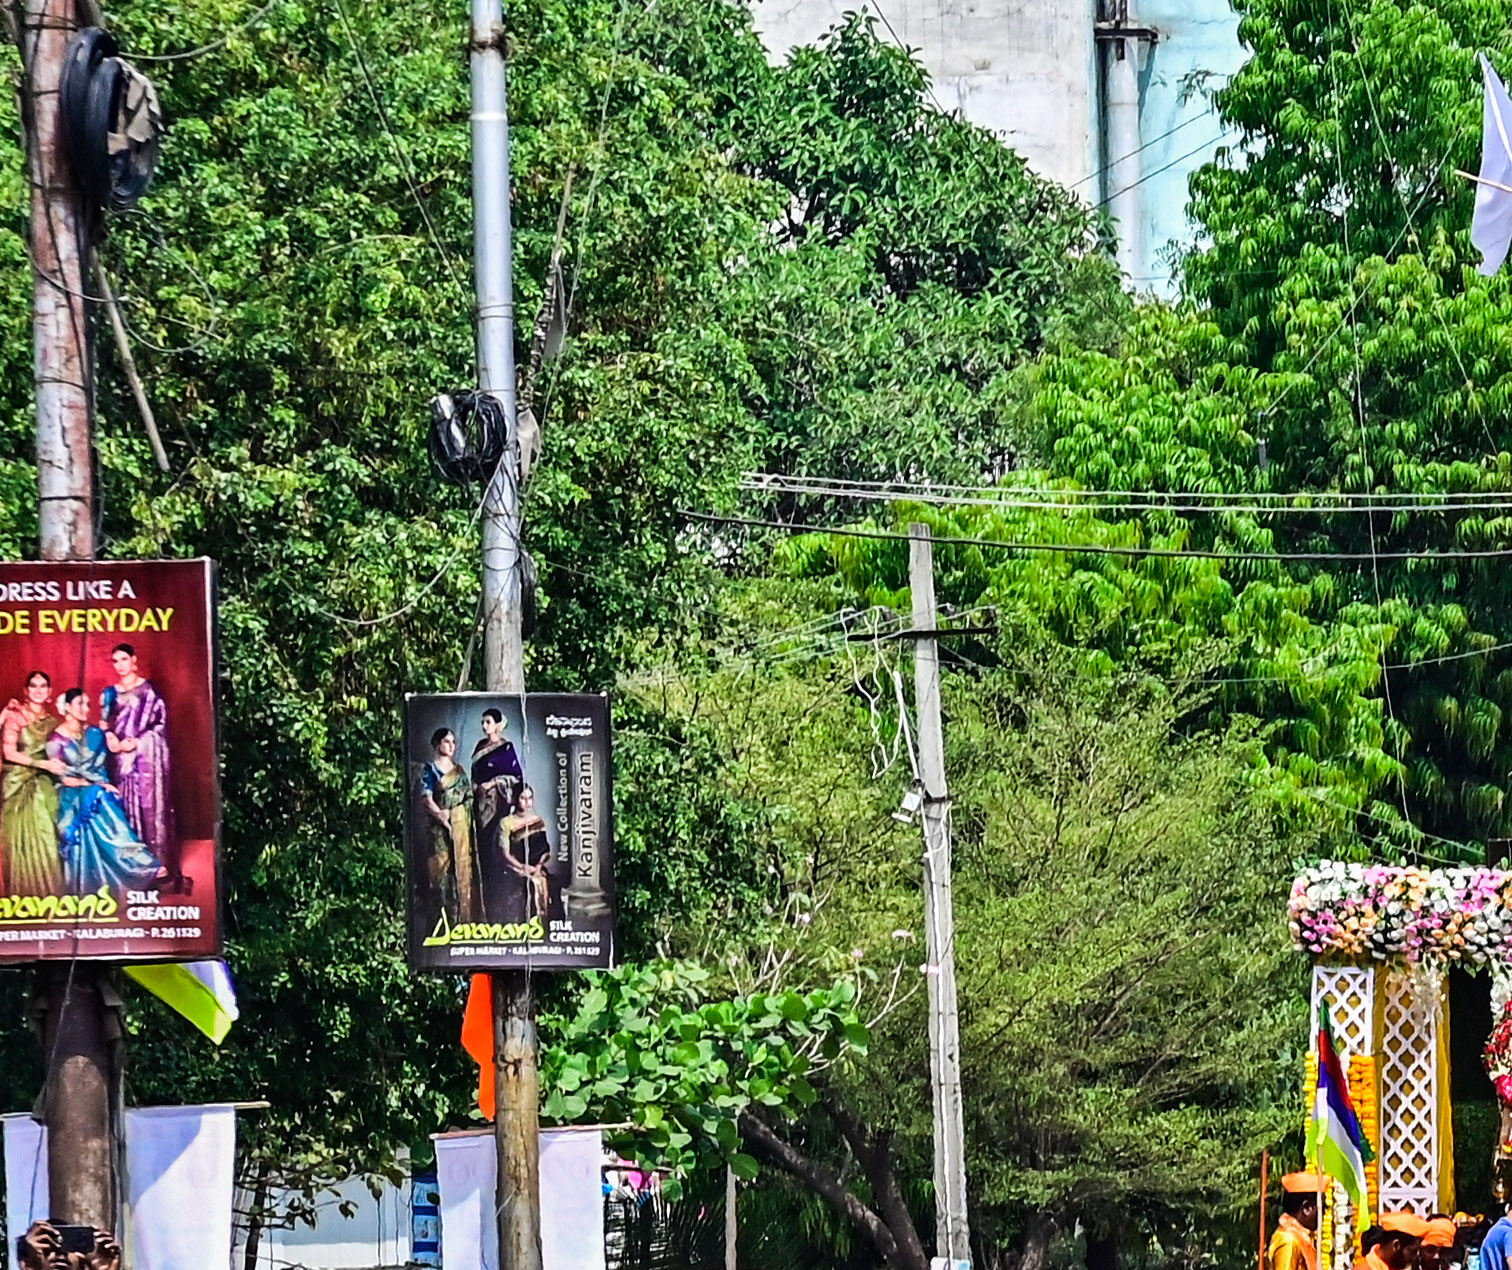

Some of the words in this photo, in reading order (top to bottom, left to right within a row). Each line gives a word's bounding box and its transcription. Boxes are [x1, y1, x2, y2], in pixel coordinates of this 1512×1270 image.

[66, 580, 113, 601] LIKE
[117, 579, 136, 599] A
[38, 608, 174, 633] EVERYDAY
[556, 751, 568, 766] of
[556, 771, 569, 839] Collection
[576, 752, 598, 879] Kanjivaram
[556, 840, 569, 862] New
[126, 891, 160, 904] SILK
[126, 906, 200, 921] CREATION
[549, 920, 572, 931] SILK
[549, 930, 600, 943] CREATION
